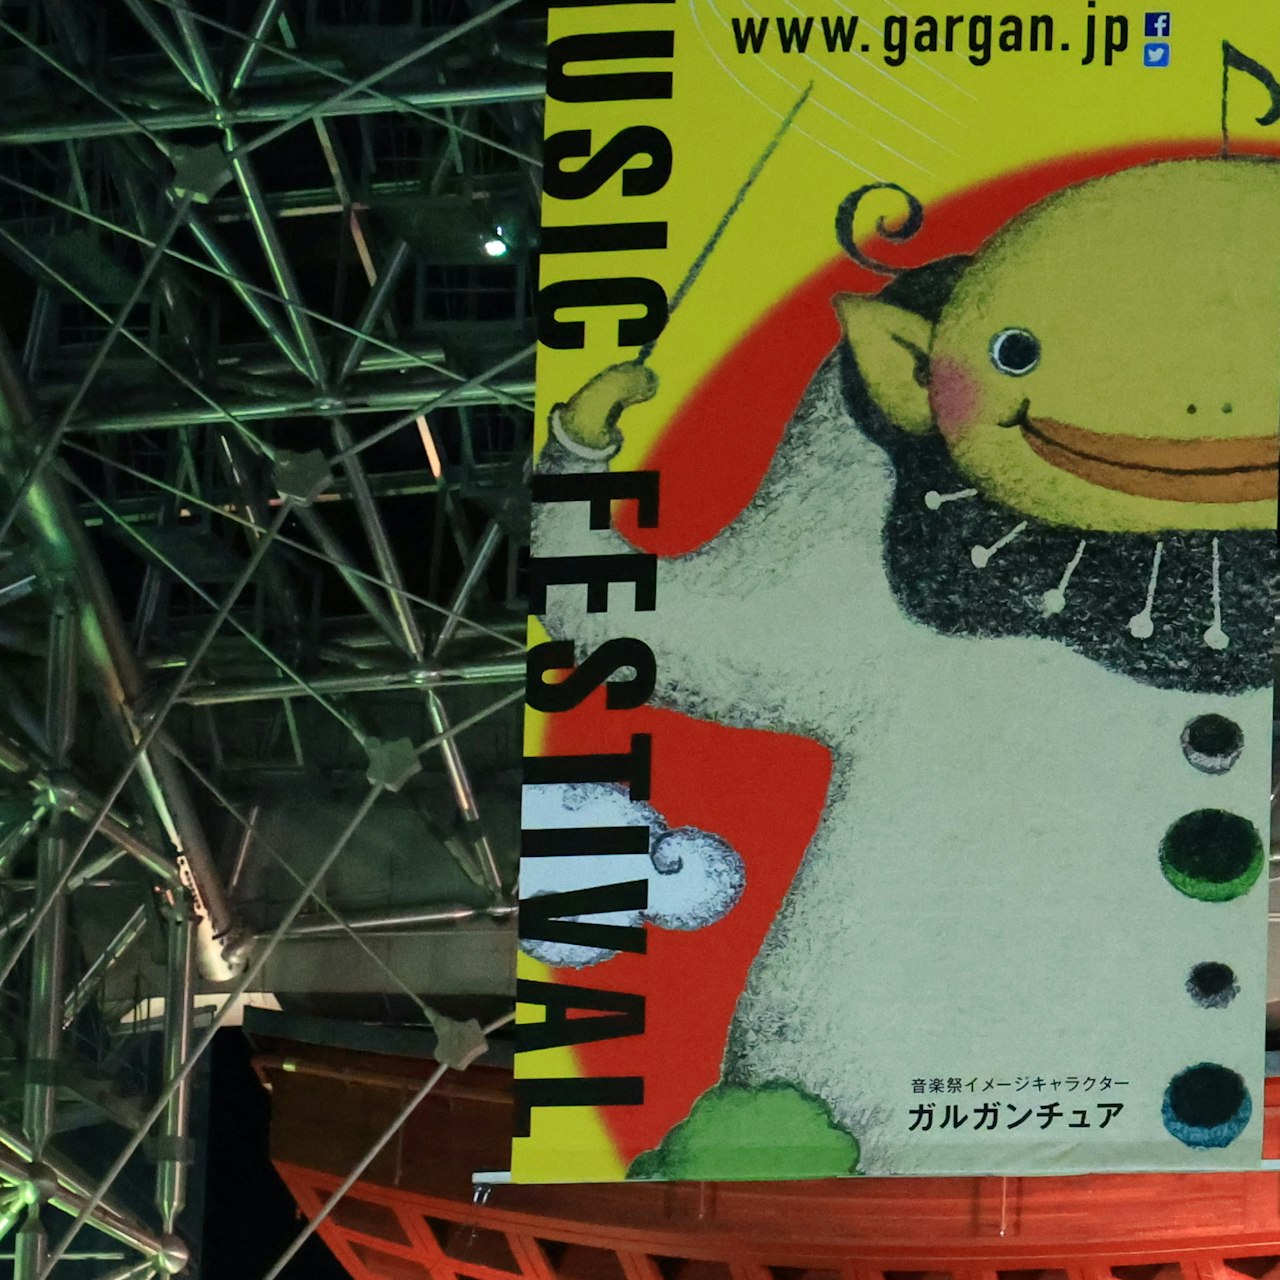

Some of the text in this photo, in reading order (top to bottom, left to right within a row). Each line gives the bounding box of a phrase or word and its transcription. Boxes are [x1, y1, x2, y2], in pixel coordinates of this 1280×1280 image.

[730, 0, 1130, 67] www.gargan.jp
[535, 0, 676, 350] USIC
[511, 469, 662, 1140] FESTIVAL
[907, 1101, 1125, 1132] ガルガンチュア
[910, 1075, 1130, 1094] 音楽祭イメージキャラクター
